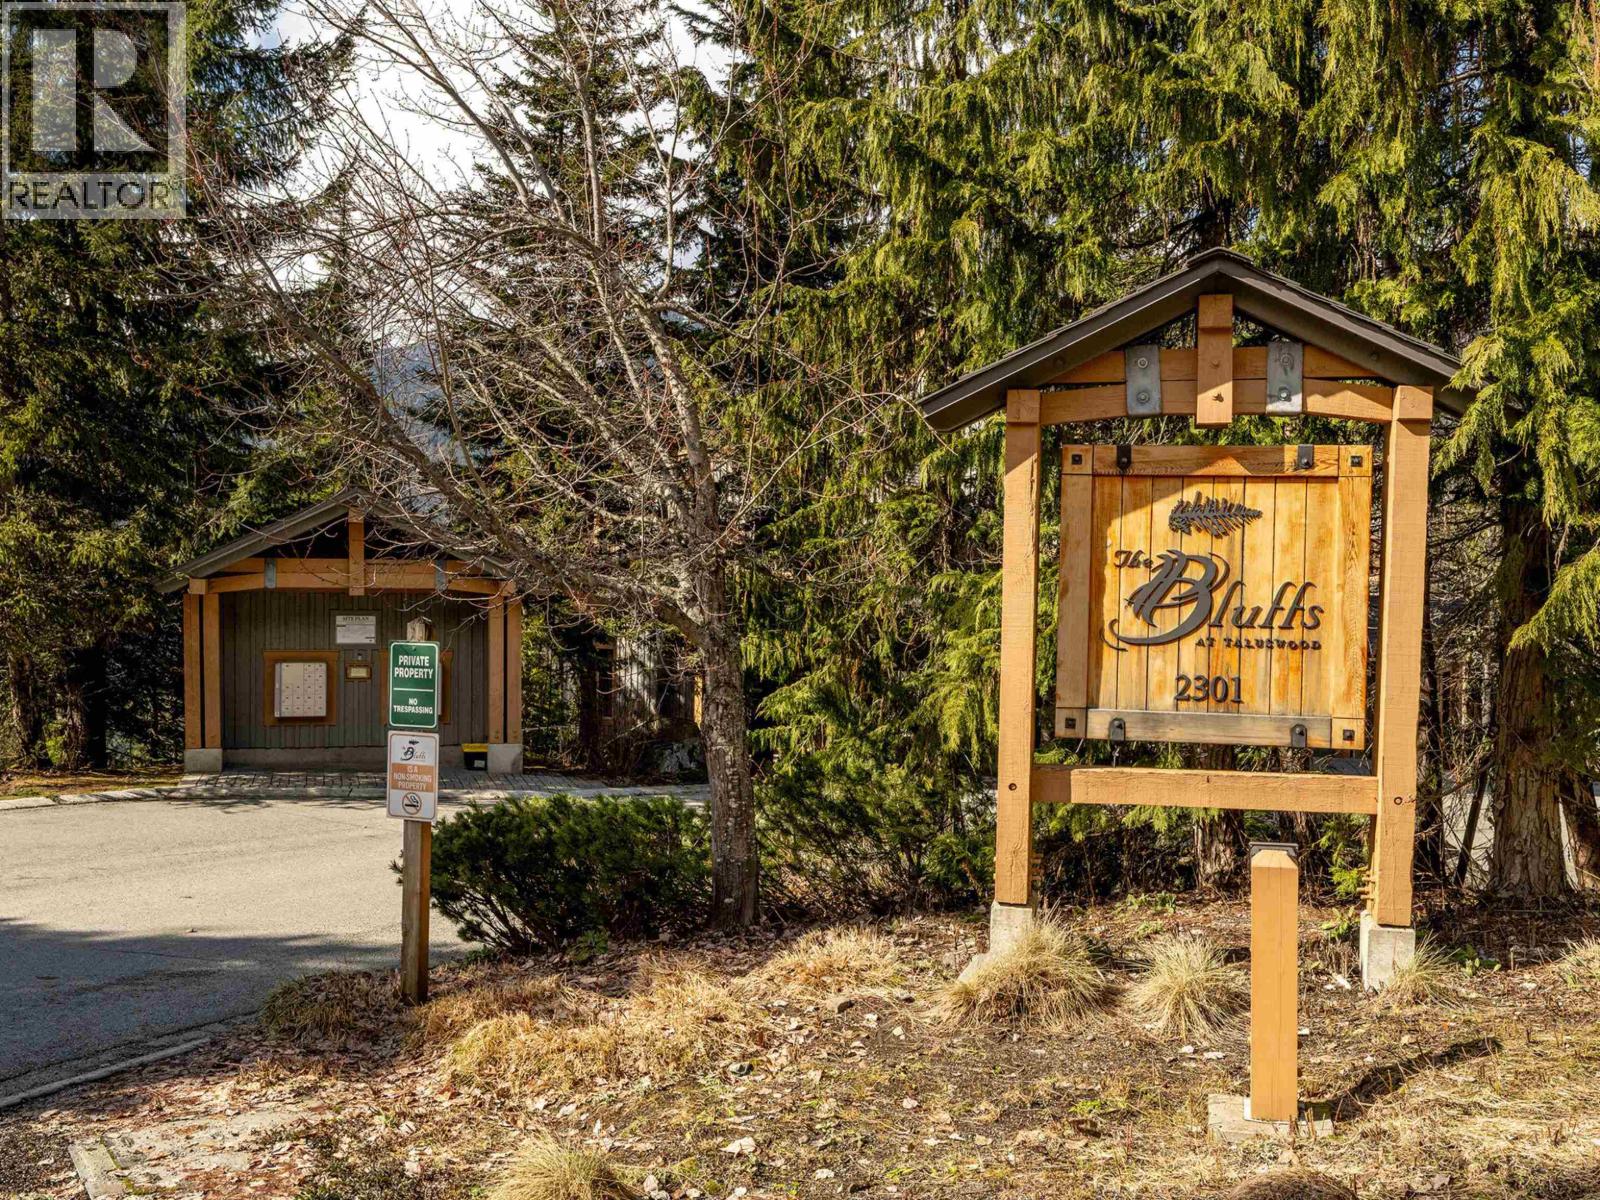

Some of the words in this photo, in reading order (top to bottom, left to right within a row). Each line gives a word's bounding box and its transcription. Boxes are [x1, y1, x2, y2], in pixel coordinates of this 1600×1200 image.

[1114, 549, 1153, 569] The
[1101, 549, 1324, 651] Bluffs
[1195, 637, 1216, 648] AT
[1223, 638, 1322, 651] TALUSWOOD
[398, 655, 430, 667] PRIVATE
[394, 667, 434, 679] PROPERTY
[1174, 675, 1244, 704] 2301
[393, 705, 433, 714] TRESPASSING
[398, 780, 427, 790] PROPERTY
